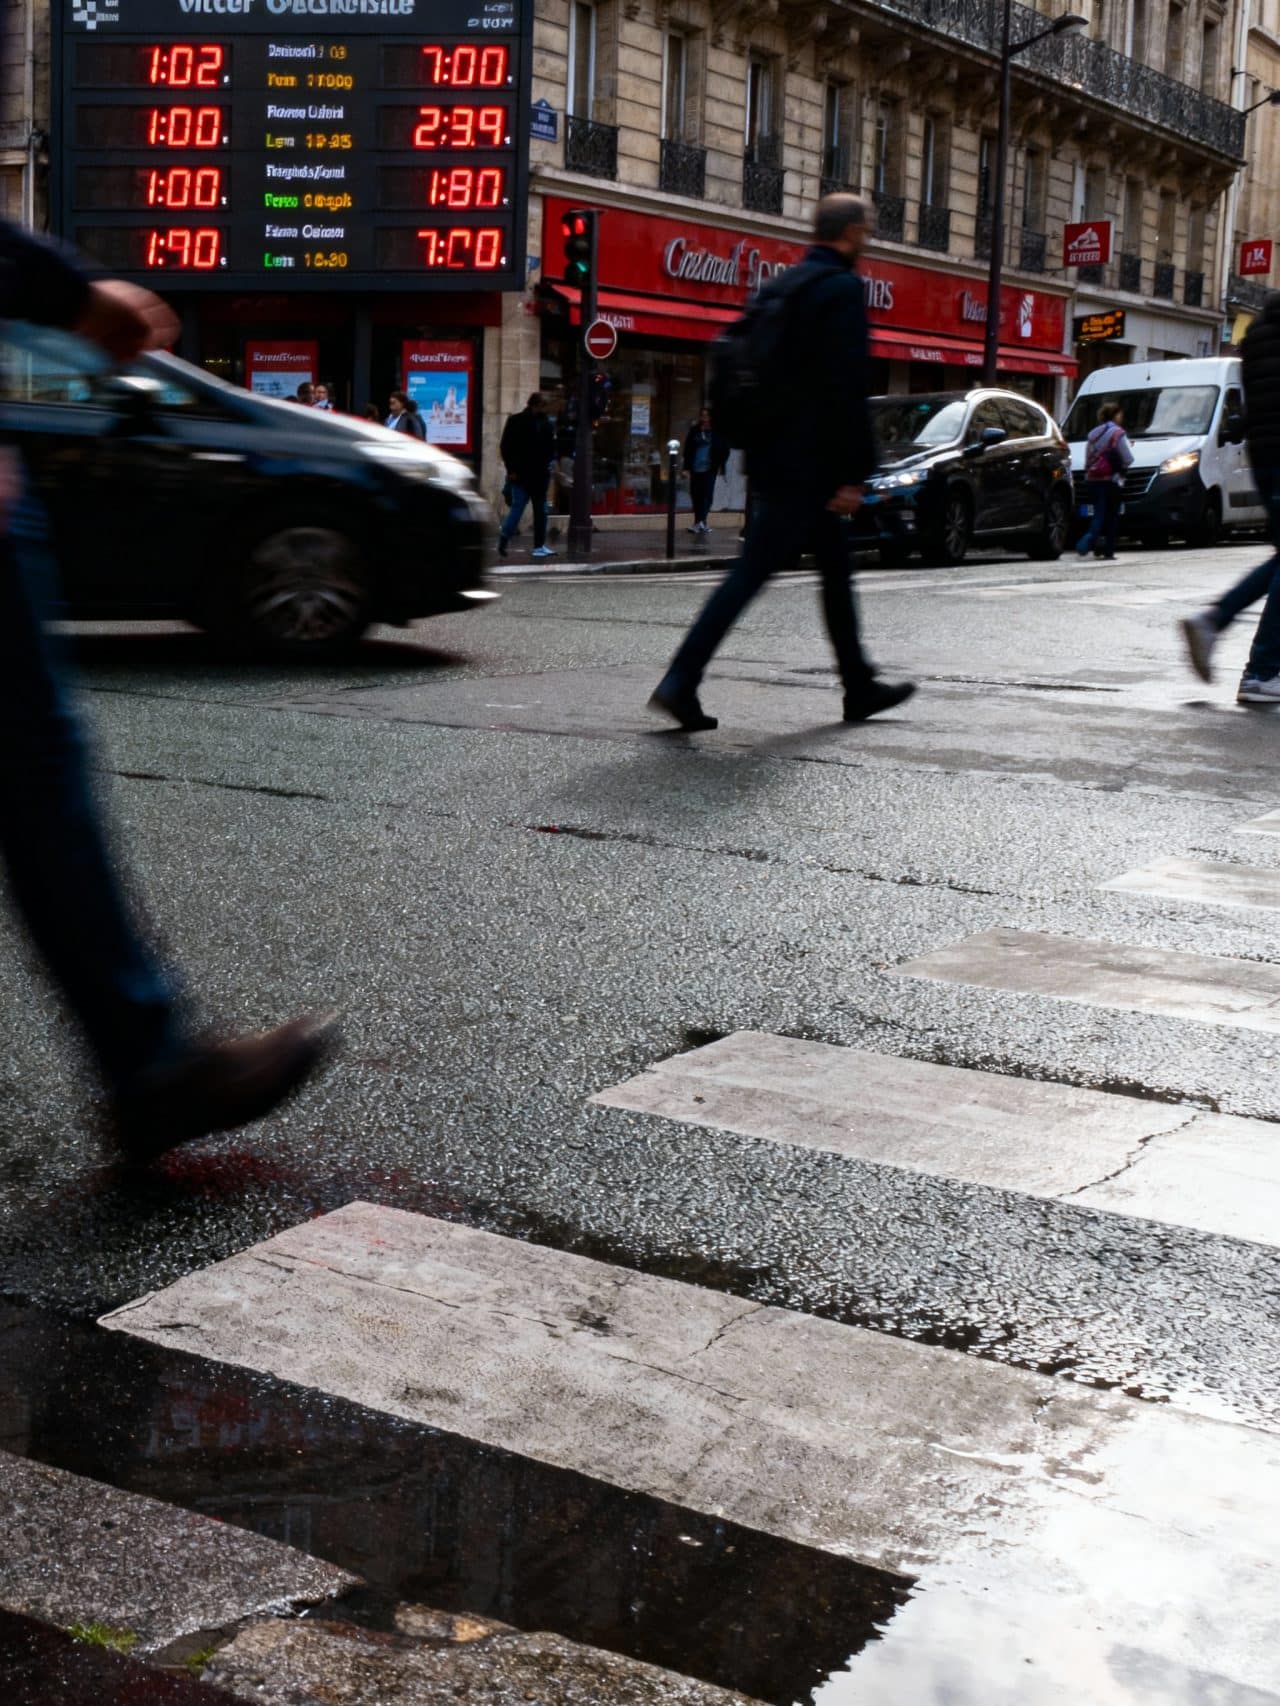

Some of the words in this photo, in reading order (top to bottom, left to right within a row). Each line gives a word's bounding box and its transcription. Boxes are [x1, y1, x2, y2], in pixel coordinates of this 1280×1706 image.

[150, 46, 223, 85] 1:02
[422, 46, 505, 86] 7:00
[149, 107, 220, 146] 1:00
[148, 168, 220, 207] 1:00
[430, 168, 501, 207] 1:80
[148, 228, 219, 267] 1:90
